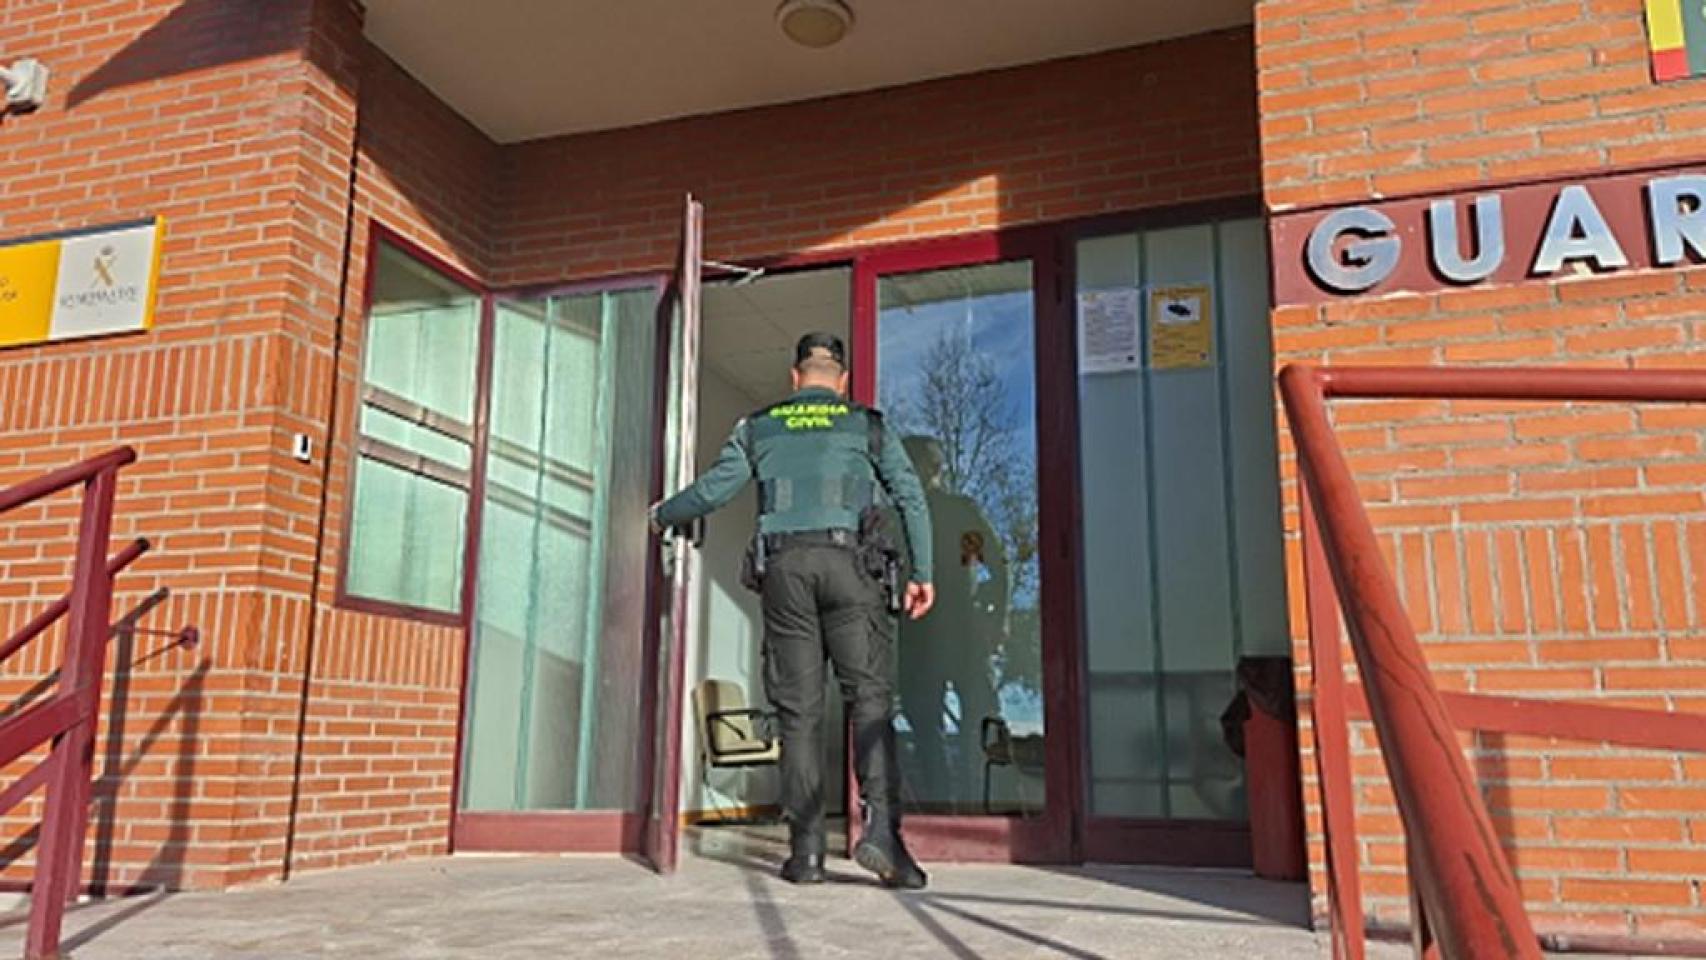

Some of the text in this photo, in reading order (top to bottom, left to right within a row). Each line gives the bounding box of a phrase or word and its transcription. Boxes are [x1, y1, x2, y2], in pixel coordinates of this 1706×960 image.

[1307, 175, 1706, 291] GUAR
[770, 404, 848, 417] GUARDIA
[786, 416, 833, 429] CIVIL
